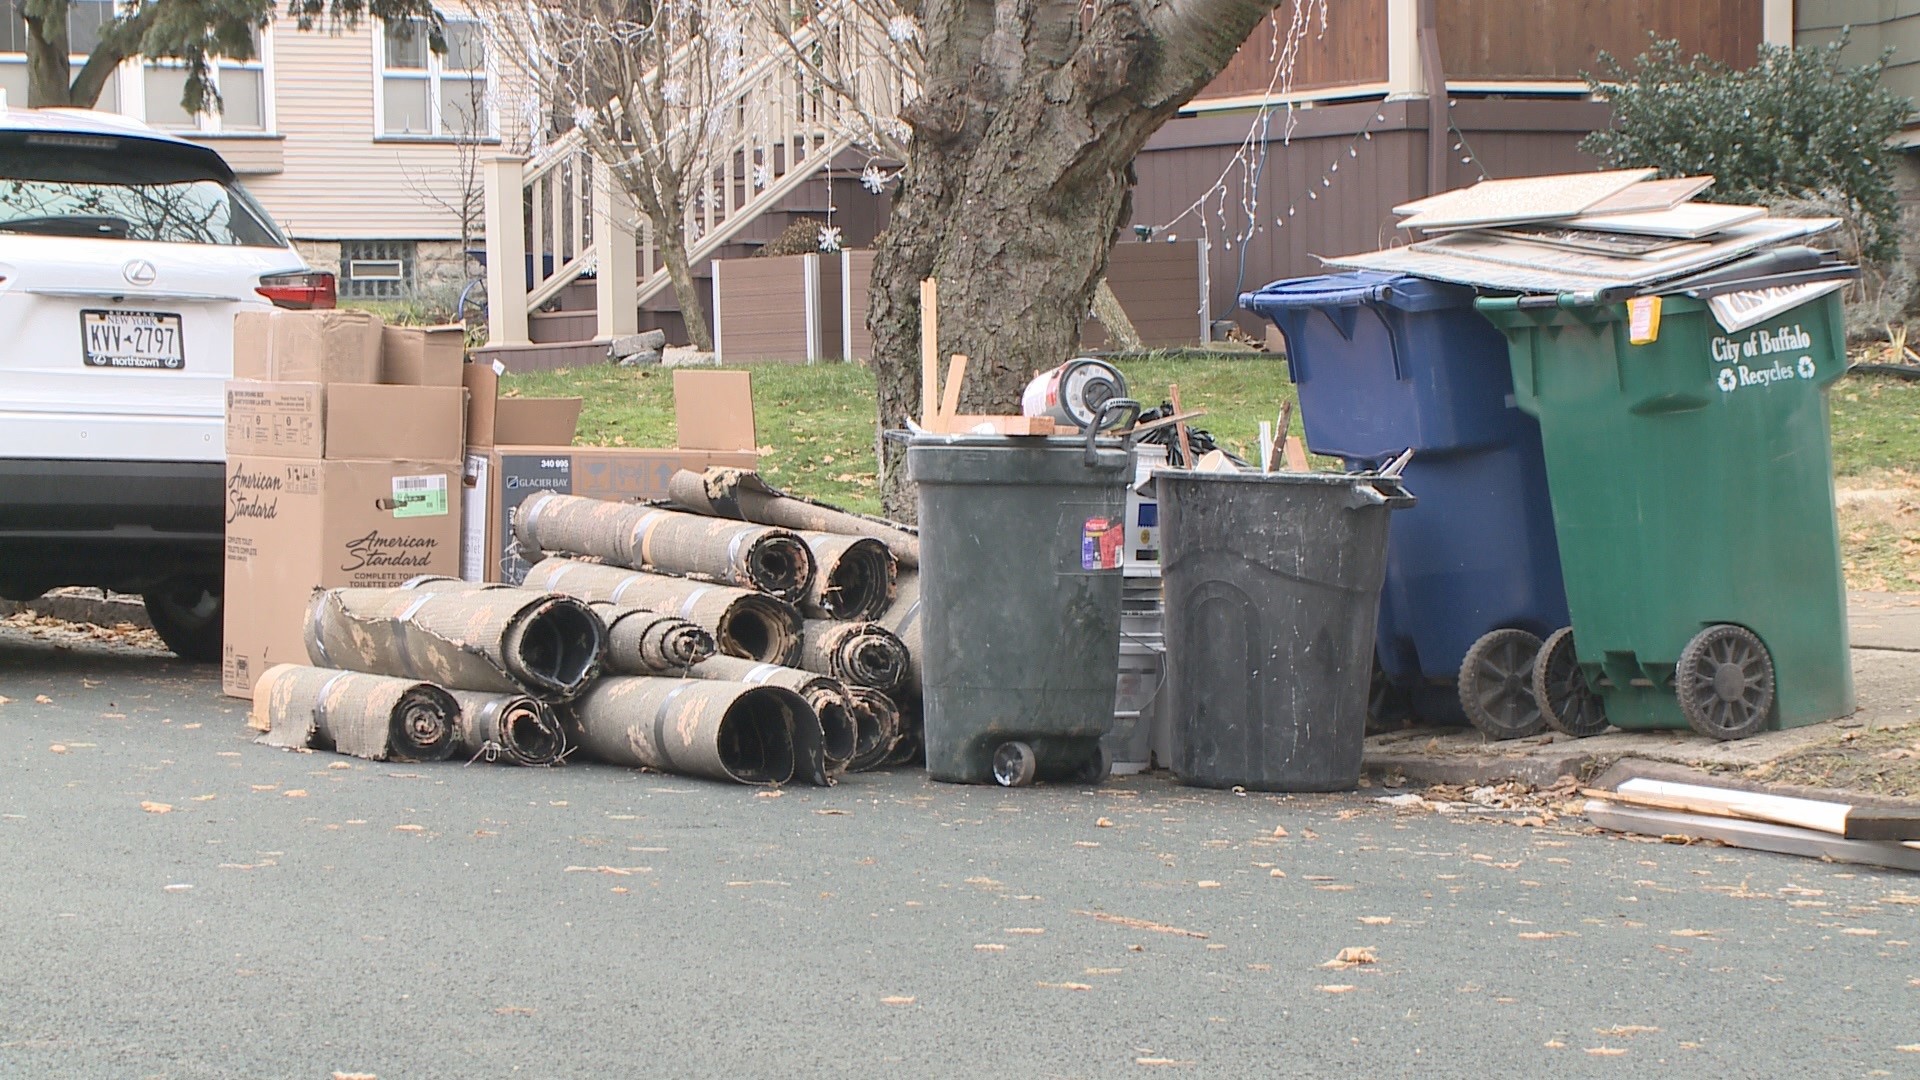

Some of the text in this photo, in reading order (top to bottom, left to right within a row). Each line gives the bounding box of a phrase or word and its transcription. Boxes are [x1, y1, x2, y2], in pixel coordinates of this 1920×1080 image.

[108, 316, 156, 327] NEW YORK
[91, 325, 174, 354] KVV 2797
[1711, 324, 1811, 364] City of Buffalo
[112, 356, 160, 367] northtown
[1738, 360, 1794, 387] Recycles
[228, 462, 283, 490] American
[519, 478, 568, 487] GLACIER BAY
[227, 489, 279, 524] Standard
[345, 530, 438, 550] American
[341, 547, 432, 571] Standard
[354, 572, 396, 580] COMPLETE
